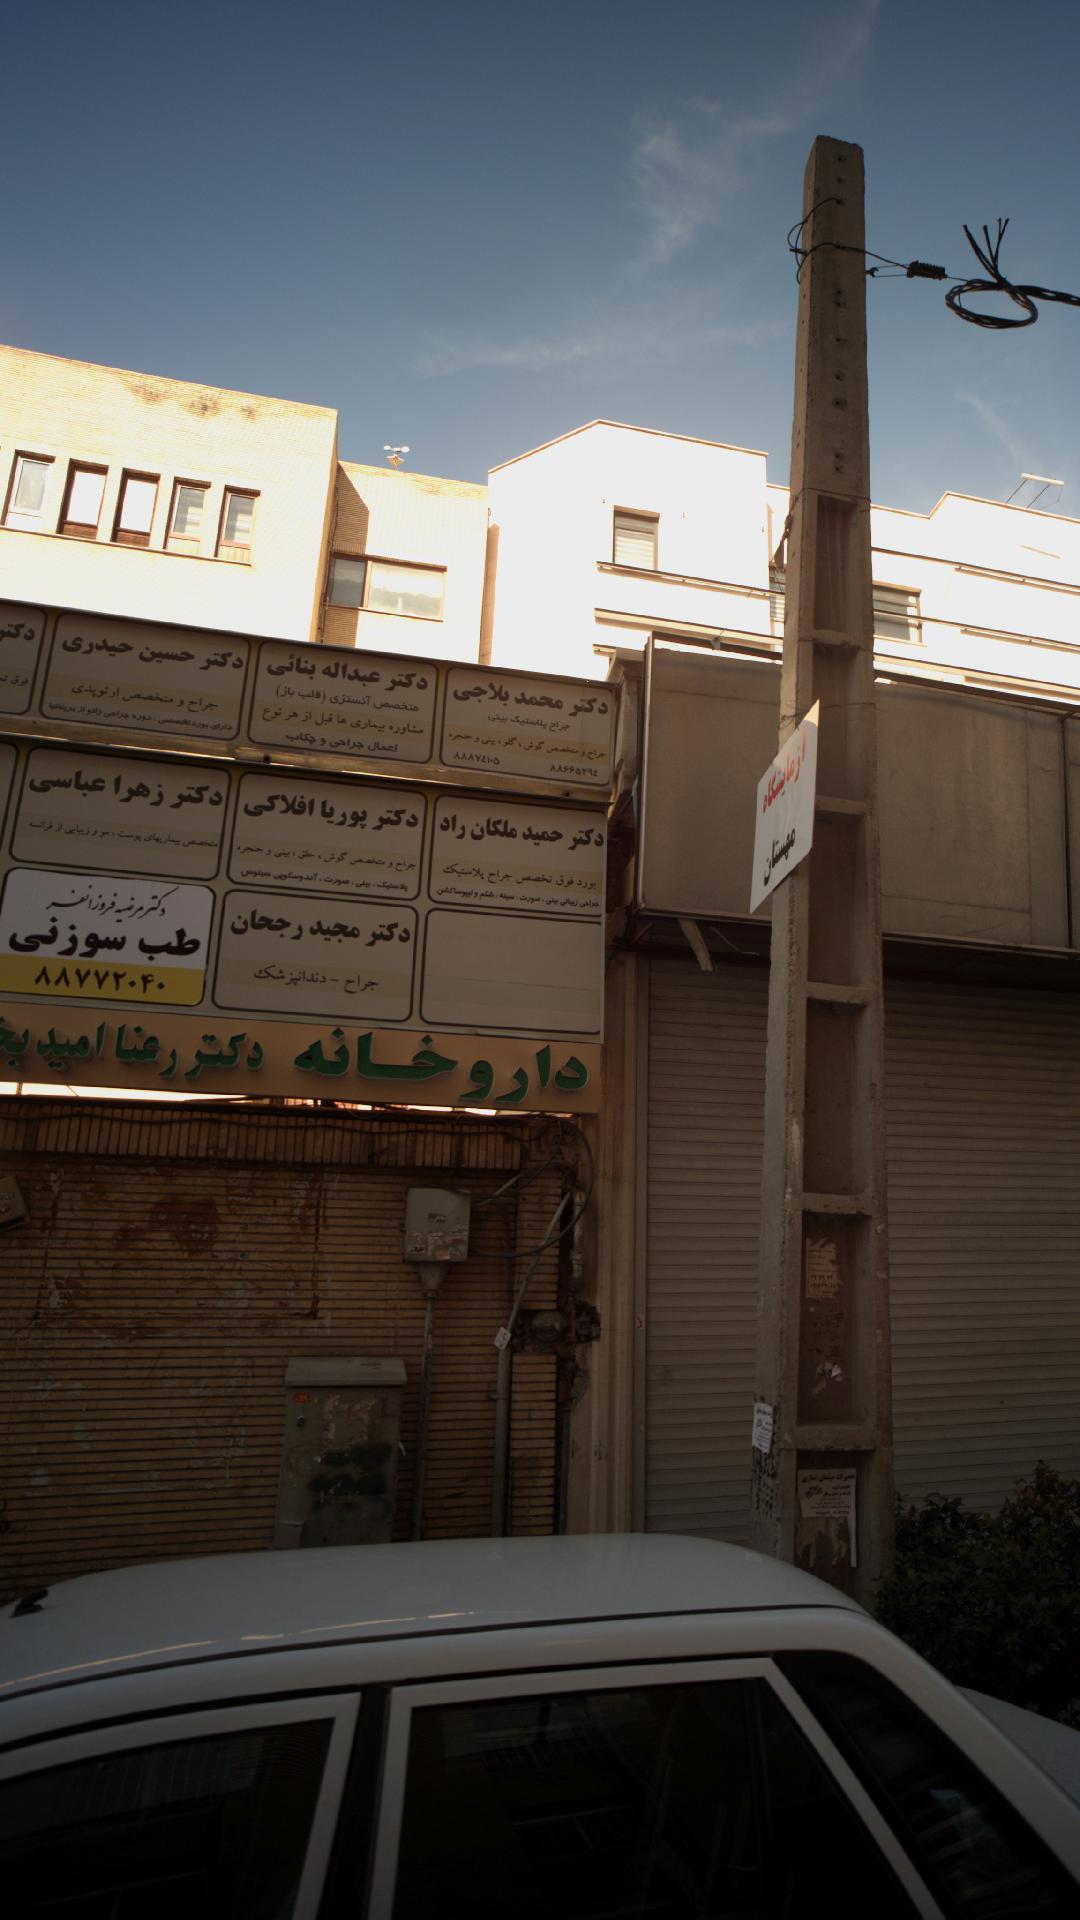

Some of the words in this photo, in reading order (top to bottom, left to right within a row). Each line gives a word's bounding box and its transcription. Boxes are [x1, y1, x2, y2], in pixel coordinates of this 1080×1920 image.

[0, 623, 35, 642] دکت
[62, 637, 133, 657] حیدری
[139, 646, 195, 663] حسین
[199, 652, 244, 670] دکتر
[267, 654, 316, 680] بنائی
[322, 661, 382, 687] عبداله
[384, 673, 428, 691] دکتر
[71, 685, 120, 699] ارتوپدی
[121, 692, 174, 703] متخصص
[453, 683, 510, 706] بلاجی
[515, 692, 564, 710] محمد
[187, 698, 219, 712] جراح
[373, 700, 419, 712] متخصص
[569, 697, 609, 717] دکتر
[262, 708, 282, 722] نوع
[285, 710, 299, 721] هر
[302, 711, 312, 722] از
[315, 712, 333, 727] قبل
[510, 715, 547, 730] پلاستیک
[350, 720, 386, 732] بیماری
[389, 723, 424, 735] مشاوره
[549, 721, 570, 732] جراح
[329, 738, 365, 750] جراحی
[368, 742, 398, 752] اعمال
[29, 771, 106, 797] عباسی
[114, 774, 165, 806] زهرا
[169, 785, 224, 809] دکتر
[243, 794, 316, 817] افلاکی
[320, 800, 368, 830] پوریا
[371, 809, 419, 831] دکتر
[440, 814, 466, 839] راد
[471, 817, 517, 841] ملکان
[522, 826, 563, 846] حمید
[182, 839, 219, 848] متخصص
[567, 828, 605, 850] دکتر
[273, 849, 291, 858] بینی
[349, 856, 385, 865] متخصص
[395, 861, 416, 872] جراح
[443, 863, 484, 880] پلاستیک
[487, 869, 513, 884] جراح
[516, 874, 553, 884] تخصص
[555, 875, 575, 887] فوق
[577, 879, 597, 891] بورد
[137, 886, 180, 920] دکتر
[230, 909, 303, 940] رجحان
[309, 920, 361, 944] مجید
[9, 916, 127, 958] سوزنی
[364, 922, 411, 947] دکتر
[138, 928, 201, 961] طب
[35, 966, 165, 994] ۸۸۷۷۲۰۴۰
[253, 965, 327, 987] دندانپزشک
[343, 974, 379, 994] جراح
[115, 1023, 178, 1080] رعنا
[184, 1031, 264, 1081] دکتر
[294, 1027, 590, 1105] داروخانه
